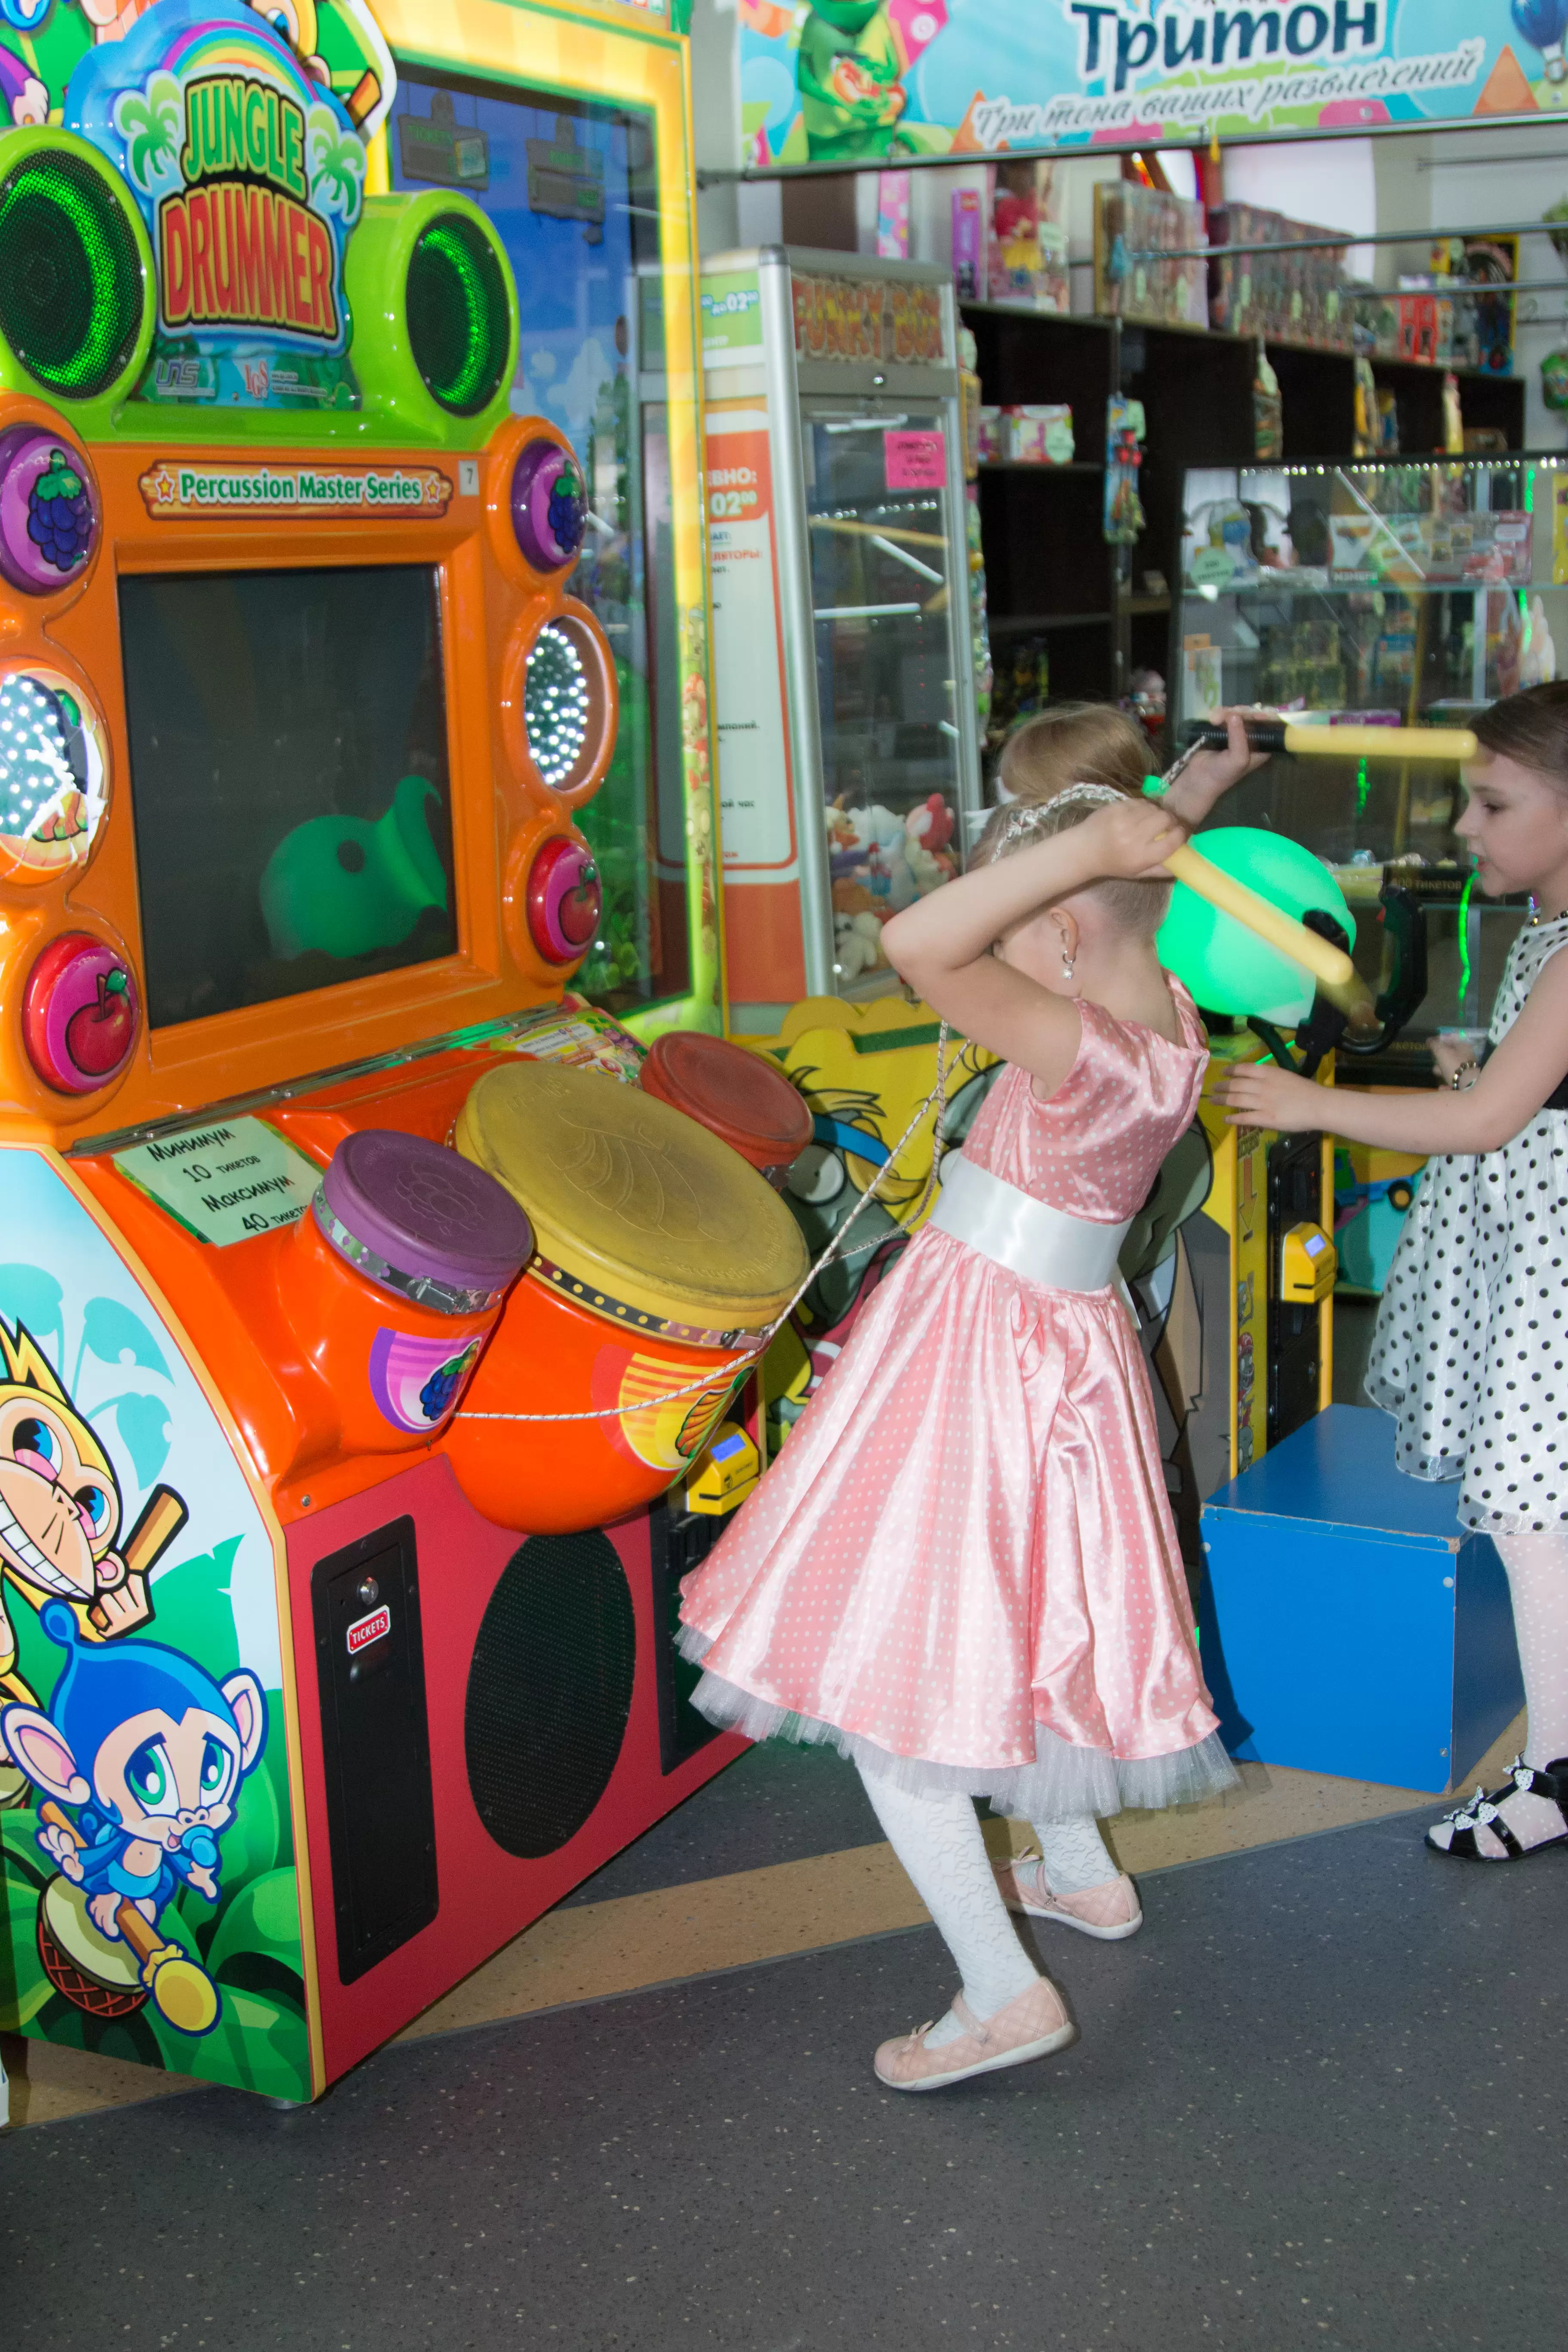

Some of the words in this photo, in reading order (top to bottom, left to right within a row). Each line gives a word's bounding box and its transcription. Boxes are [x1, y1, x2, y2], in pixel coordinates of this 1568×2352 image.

[1072, 1, 1377, 92] Тритон
[978, 102, 1034, 140] Три
[1046, 100, 1131, 126] тона
[1140, 86, 1248, 121] ваших
[1256, 52, 1477, 115] развлечений
[184, 77, 307, 199] JUNGLE
[162, 185, 337, 335] DRUMMER
[181, 468, 294, 500] Percussion
[299, 474, 364, 500] Master
[366, 472, 421, 501] Series
[466, 468, 474, 485] 7
[146, 1127, 237, 1162] Минимум
[183, 1164, 212, 1183] 10
[216, 1155, 261, 1174] тикетов
[201, 1175, 296, 1213] Максимум
[242, 1212, 270, 1231] 40
[270, 1205, 308, 1224] тикето
[351, 1617, 386, 1645] TICKETS
